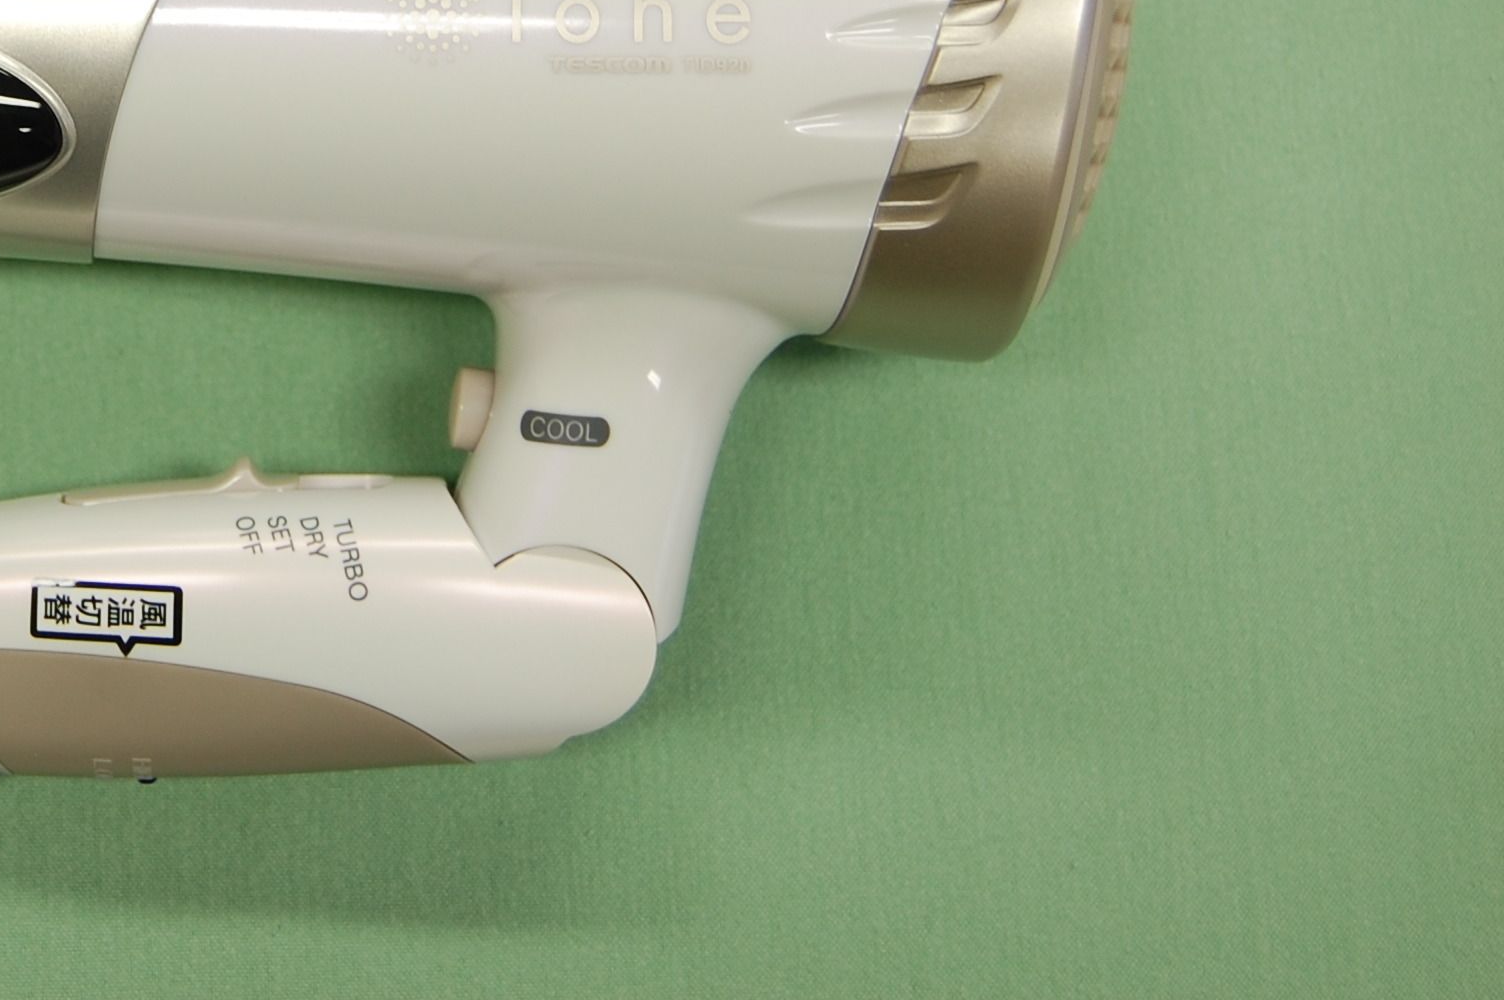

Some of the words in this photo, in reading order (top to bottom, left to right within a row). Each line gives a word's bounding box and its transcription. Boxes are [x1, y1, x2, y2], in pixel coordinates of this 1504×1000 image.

[529, 415, 598, 442] COOL
[235, 515, 264, 556] OFF
[267, 515, 296, 552] SET
[299, 515, 329, 559] DRY
[333, 518, 369, 602] TURBO
[43, 594, 167, 631] 風温切替
